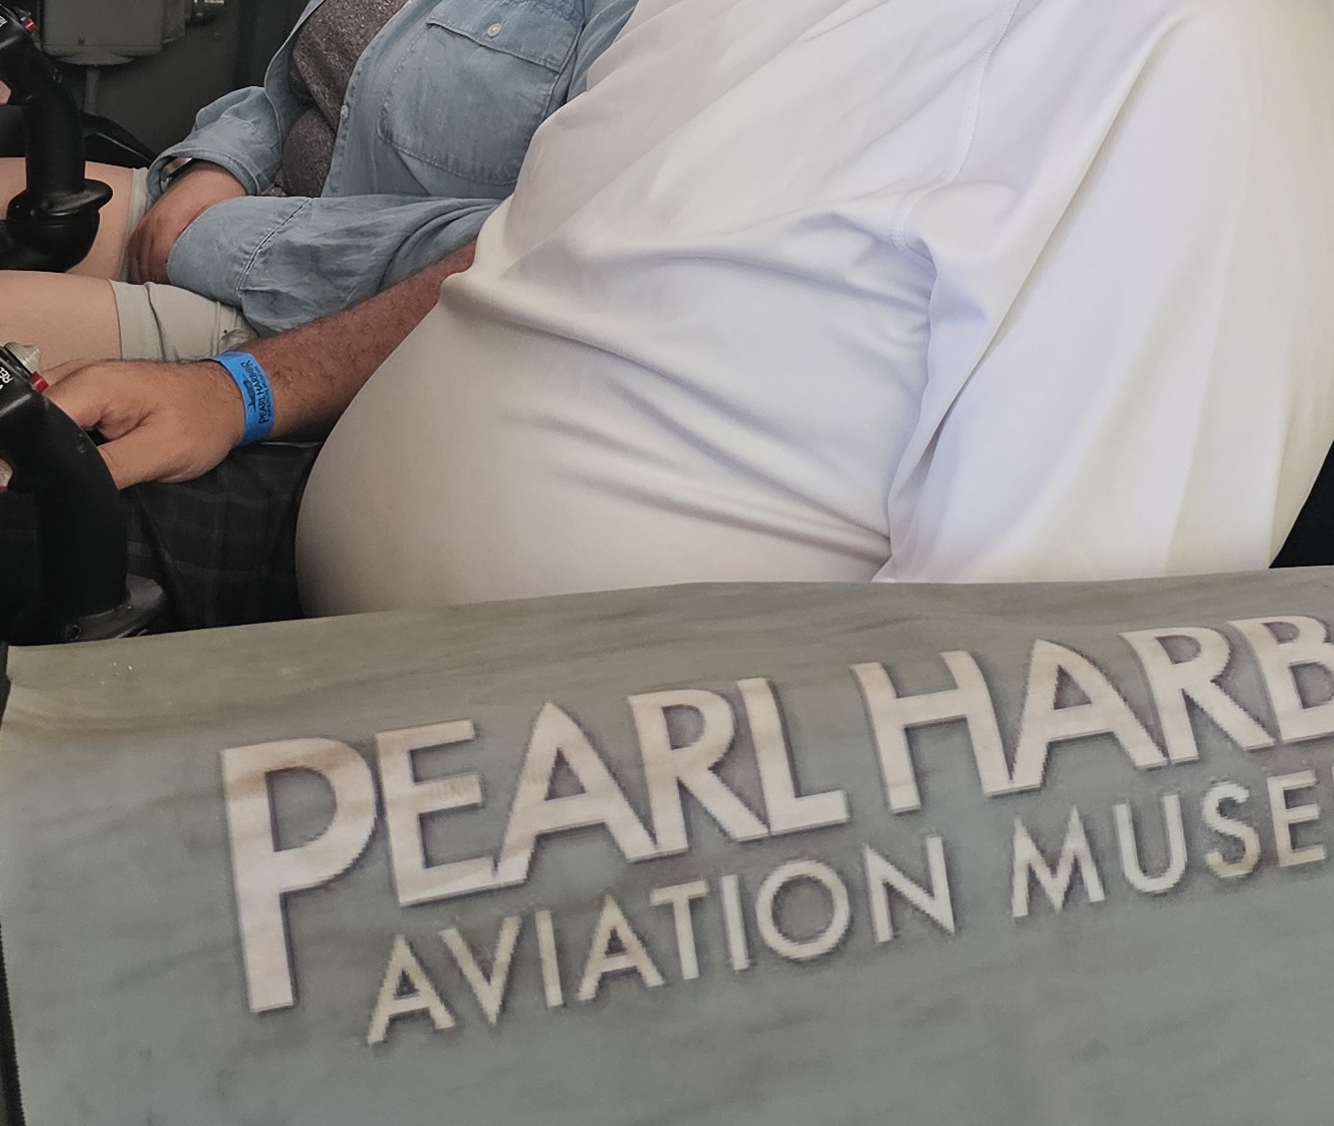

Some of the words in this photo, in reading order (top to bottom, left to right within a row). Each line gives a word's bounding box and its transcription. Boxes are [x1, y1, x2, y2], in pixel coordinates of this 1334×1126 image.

[240, 359, 264, 395] HARBOR
[257, 397, 270, 424] PEARL
[220, 674, 851, 1016] PEARL
[364, 830, 963, 1050] AVIATION
